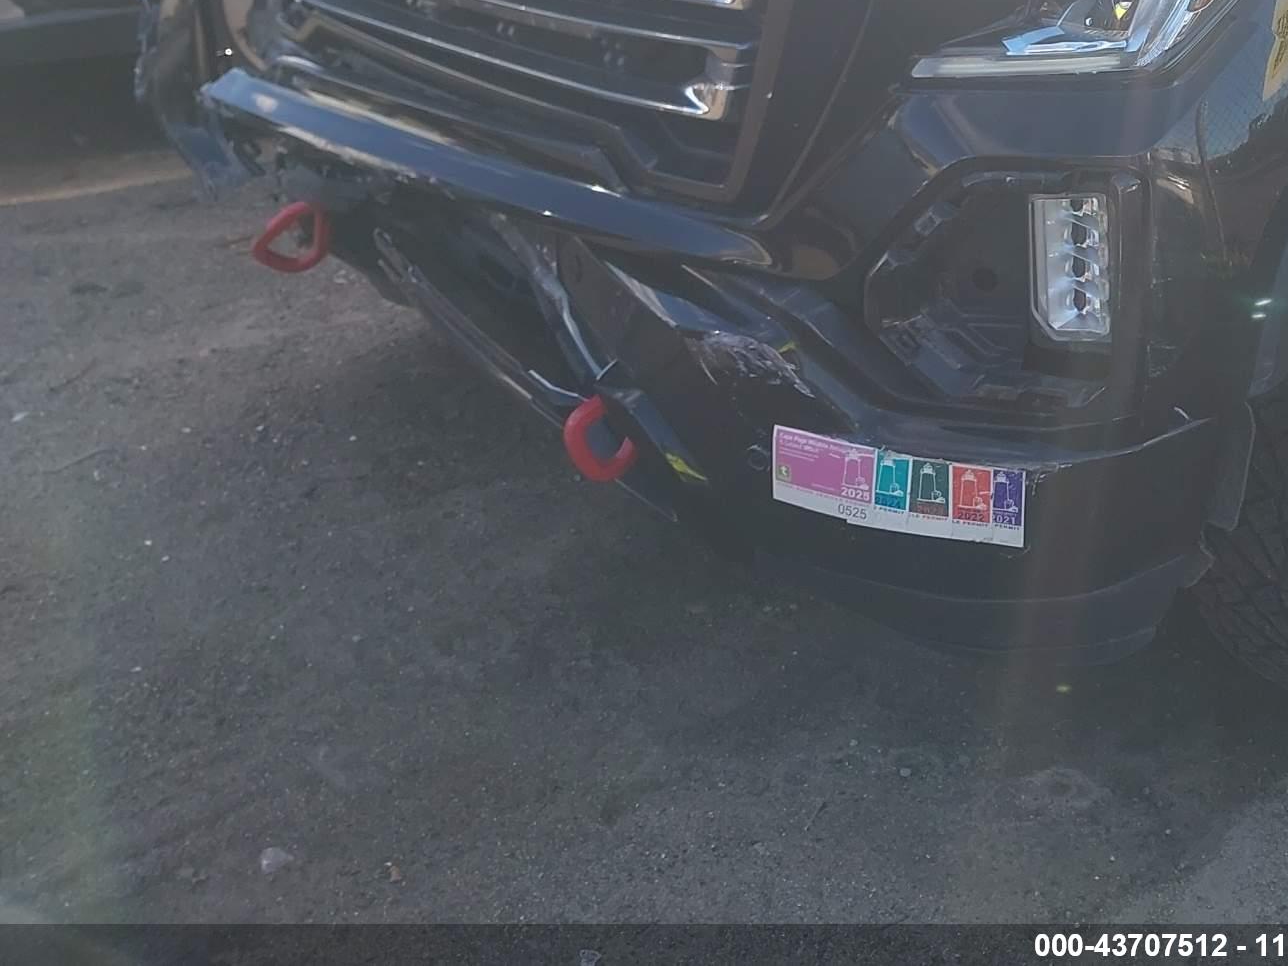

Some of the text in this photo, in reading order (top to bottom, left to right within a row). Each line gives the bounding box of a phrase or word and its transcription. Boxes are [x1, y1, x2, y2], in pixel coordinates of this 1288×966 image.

[841, 486, 871, 502] 2025
[838, 504, 868, 520] 0525
[958, 512, 985, 522] 2022
